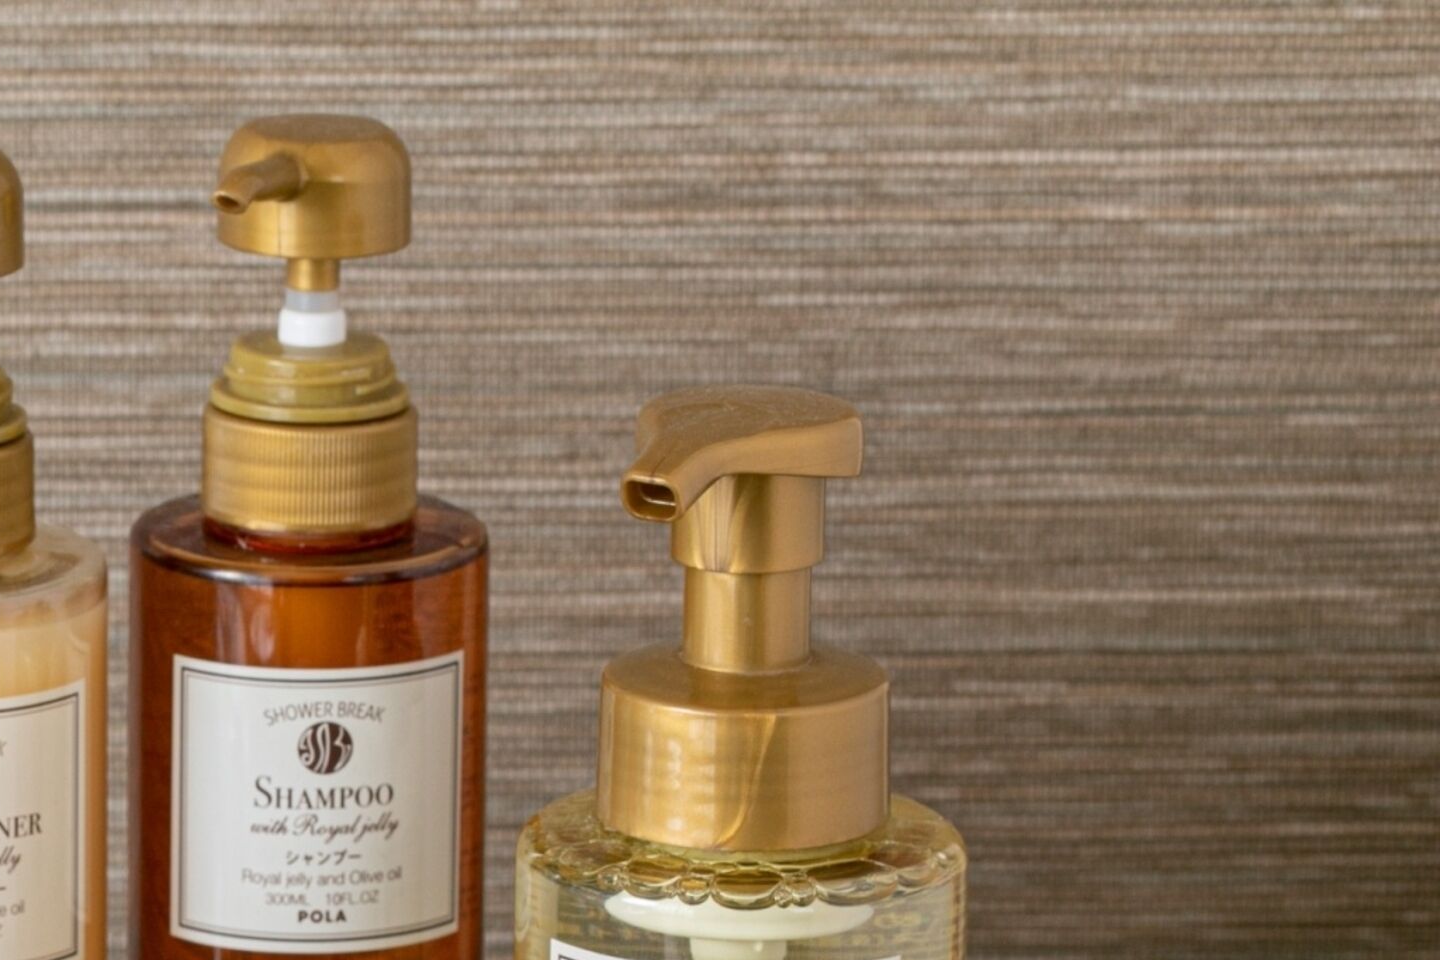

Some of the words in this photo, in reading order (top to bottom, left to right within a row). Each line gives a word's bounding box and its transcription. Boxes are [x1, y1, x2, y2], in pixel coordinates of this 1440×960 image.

[263, 701, 333, 727] SHOWER
[337, 701, 386, 723] BREAK
[253, 775, 394, 810] SHAMPOO
[250, 816, 289, 836] with
[292, 813, 357, 844] Royal
[354, 811, 399, 842] jelly
[286, 849, 362, 866] シャンプー
[241, 868, 282, 888] Royal
[285, 870, 312, 888] jelly
[317, 872, 345, 886] and
[349, 869, 384, 885] Olive
[387, 866, 403, 881] oil
[10, 900, 25, 915] oil
[298, 910, 347, 924] POLA
